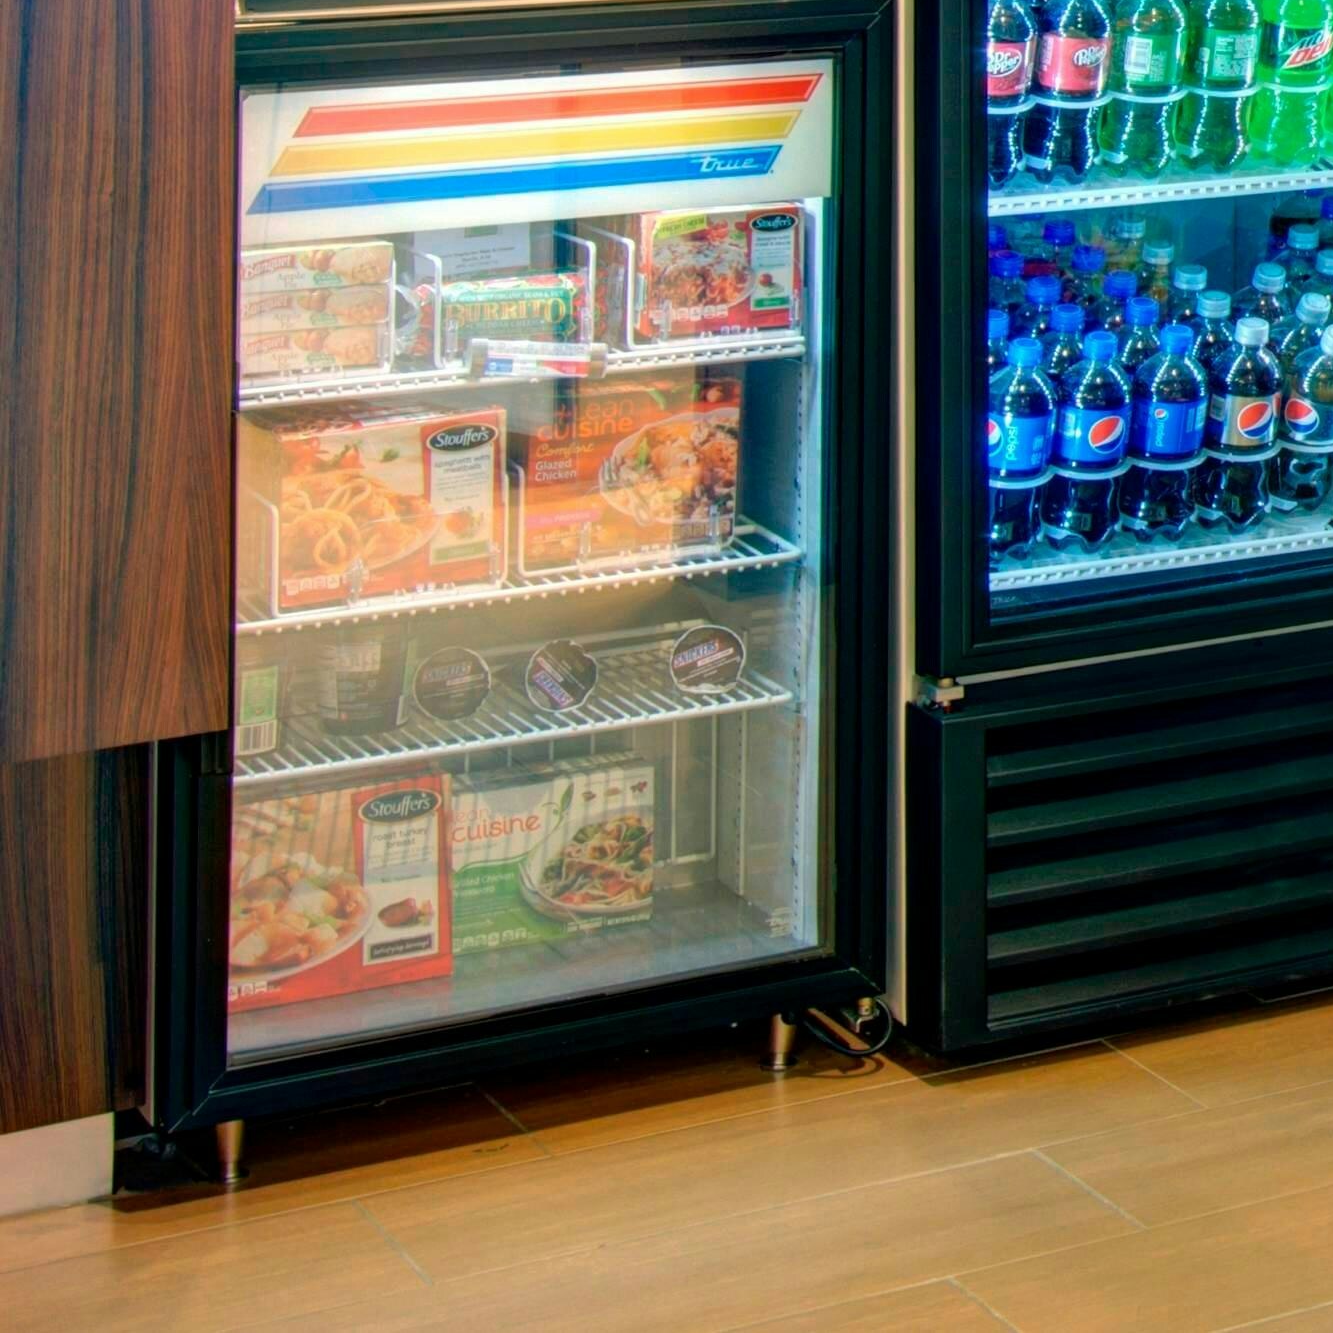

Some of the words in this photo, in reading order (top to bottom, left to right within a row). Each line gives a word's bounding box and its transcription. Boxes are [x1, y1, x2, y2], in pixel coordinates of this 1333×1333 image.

[690, 154, 760, 174] true
[755, 216, 793, 228] Stouffer's
[435, 425, 490, 447] Stouffer's
[368, 792, 431, 816] Stouffer's
[452, 814, 542, 843] cuisine
